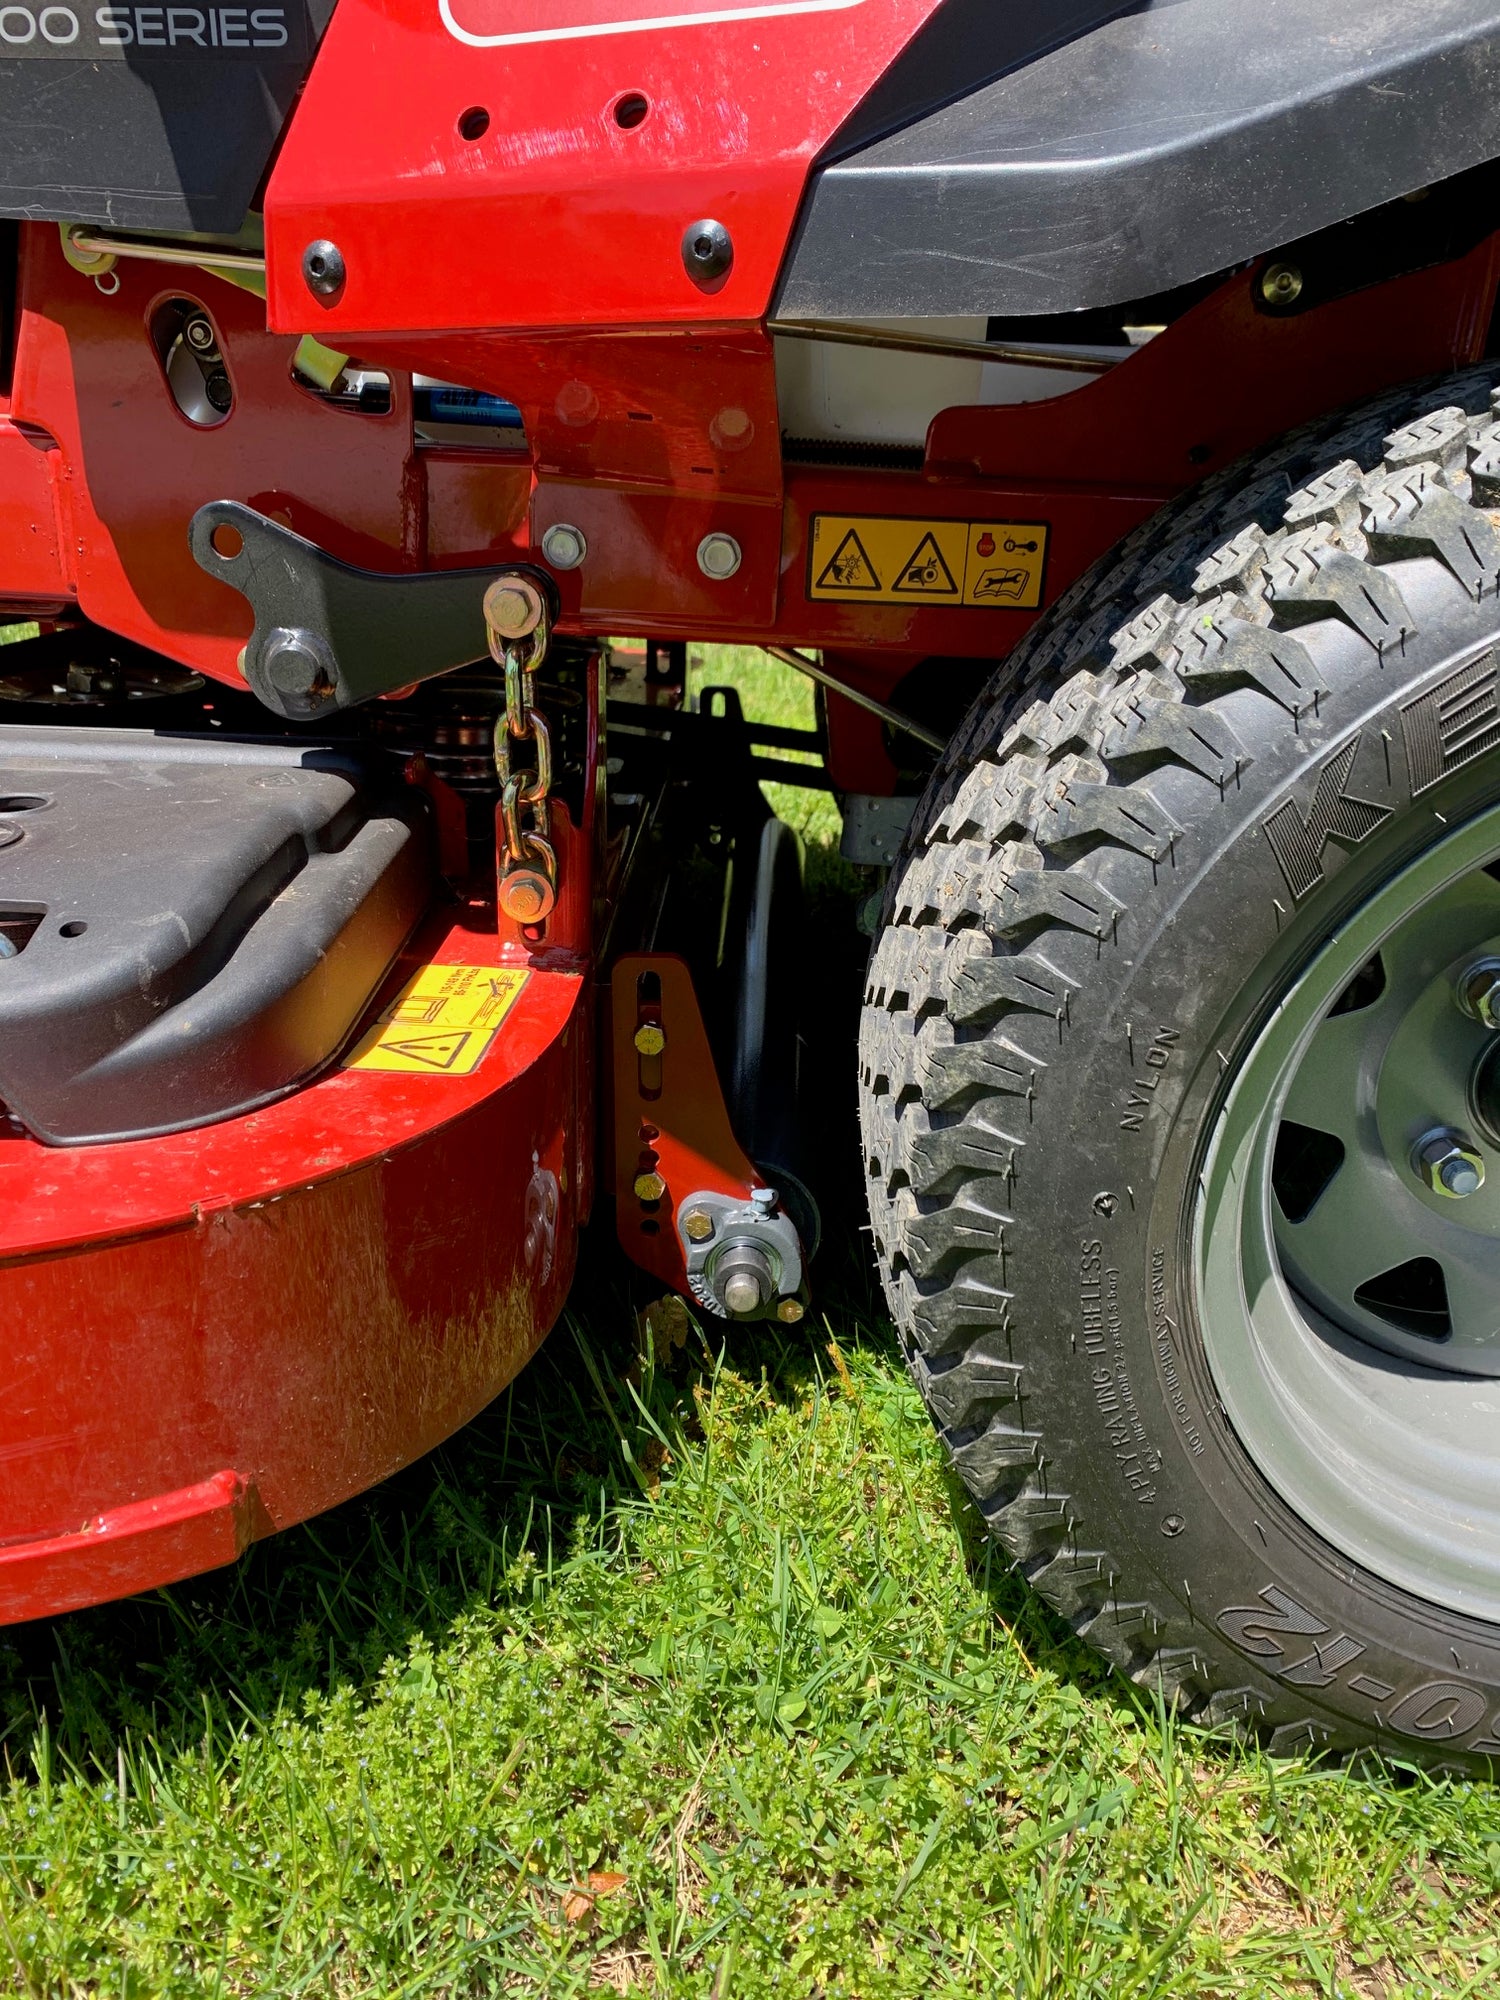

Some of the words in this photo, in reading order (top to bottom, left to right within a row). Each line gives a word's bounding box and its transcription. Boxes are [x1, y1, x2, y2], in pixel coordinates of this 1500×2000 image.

[96, 7, 288, 47] SERIES
[1119, 1025, 1181, 1132] NYLON
[1080, 1239, 1106, 1356] TUBELESS
[1152, 1245, 1165, 1317] SERVICE
[1155, 1318, 1180, 1392] HIGHWAY
[1093, 1367, 1131, 1446] RATING
[1118, 1374, 1147, 1442] INFLATION
[1171, 1391, 1191, 1425] FOR
[1117, 1453, 1150, 1491] PLY
[1184, 1425, 1206, 1457] NOT
[1138, 1491, 1156, 1504] 4
